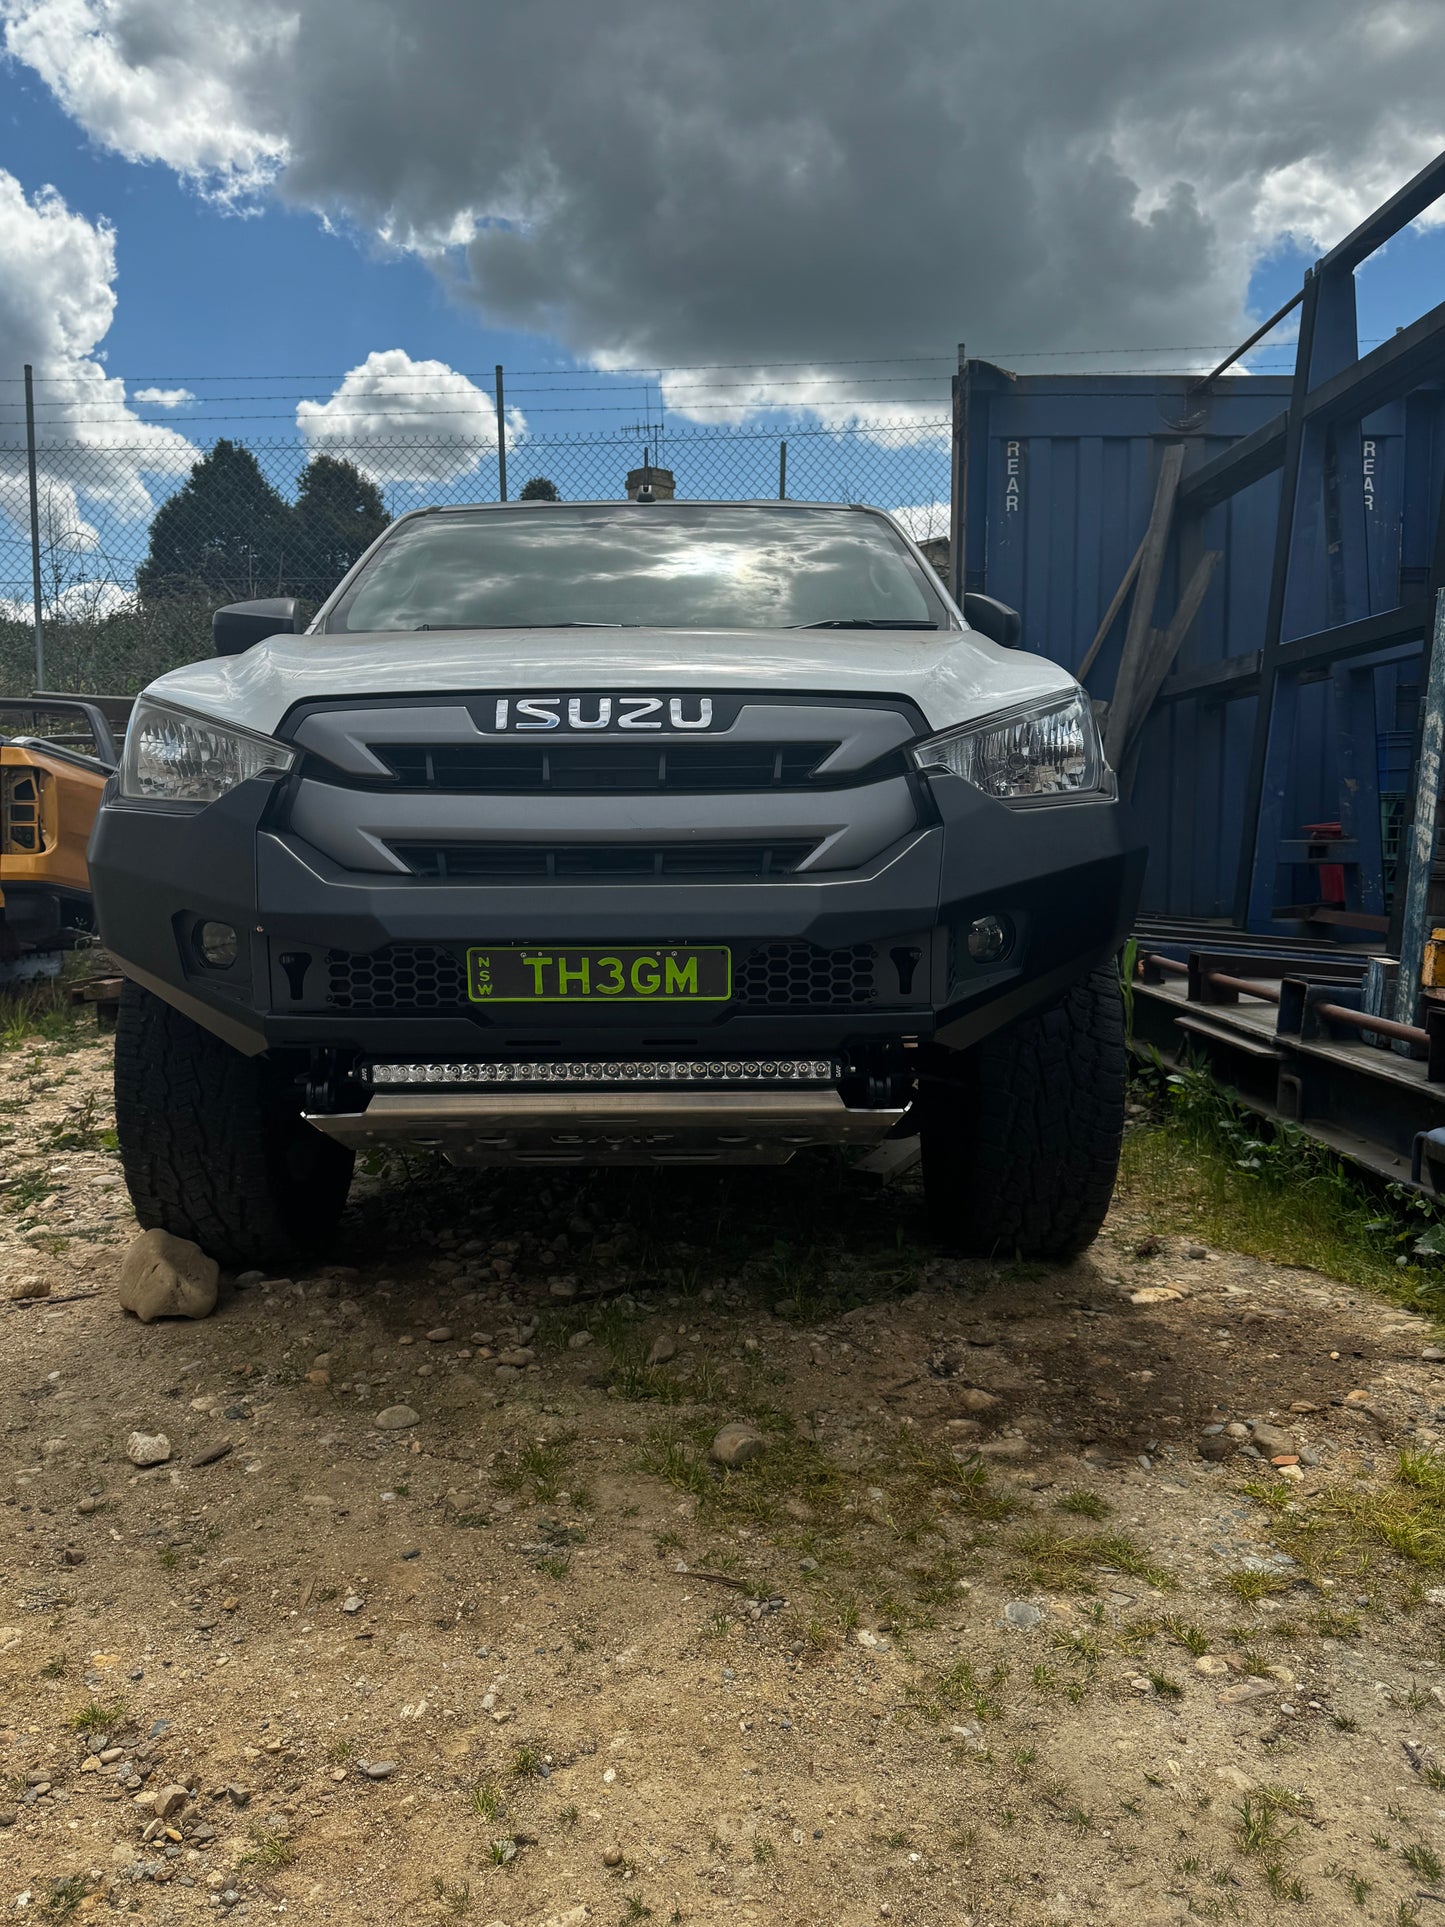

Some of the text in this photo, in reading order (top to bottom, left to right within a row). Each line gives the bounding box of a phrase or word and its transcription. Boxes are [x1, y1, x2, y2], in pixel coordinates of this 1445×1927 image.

[1006, 441, 1020, 511] REAR
[1363, 441, 1376, 510] REAR
[495, 698, 712, 729] ISUZU
[477, 956, 493, 995] NSW
[523, 957, 698, 994] TH3GM
